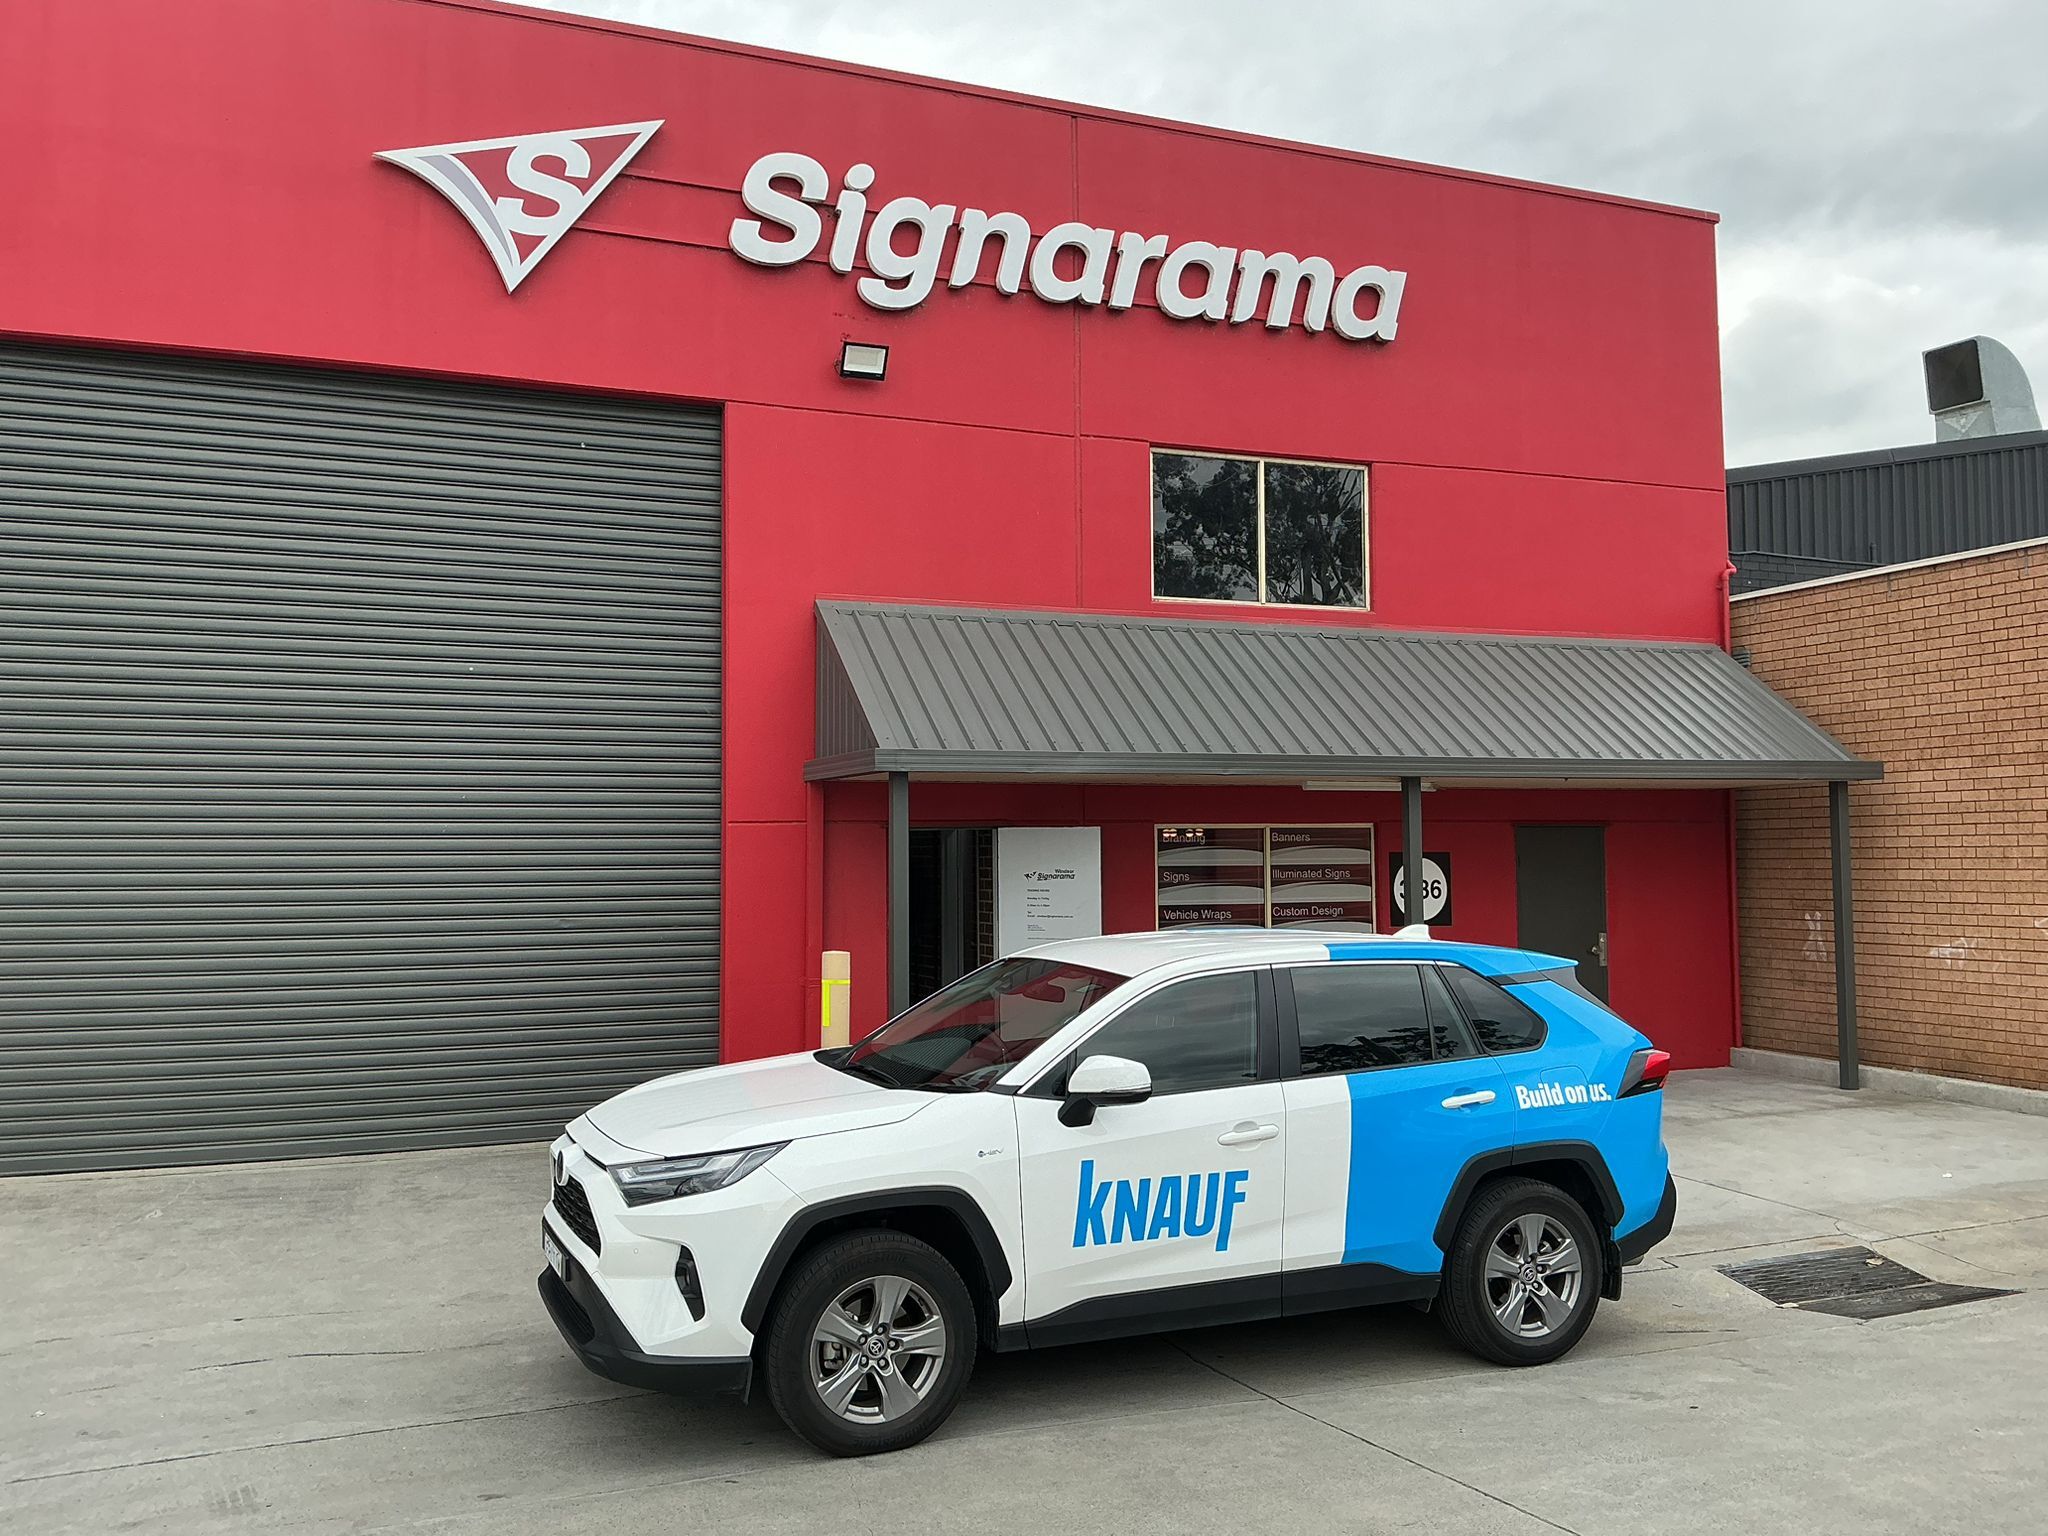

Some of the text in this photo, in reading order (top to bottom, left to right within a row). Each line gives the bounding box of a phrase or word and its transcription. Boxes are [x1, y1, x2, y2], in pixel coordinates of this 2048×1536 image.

[728, 152, 1407, 342] Signarama
[1271, 832, 1311, 842] Banners
[1036, 872, 1076, 881] Signarama
[1163, 871, 1190, 883] Signs
[1272, 868, 1351, 880] Illuminated Signs
[1163, 909, 1232, 921] Vehicle Wraps
[1272, 905, 1344, 917] Custom Design
[1515, 1082, 1612, 1109] Build on us.
[1072, 1159, 1249, 1252] KNAUF
